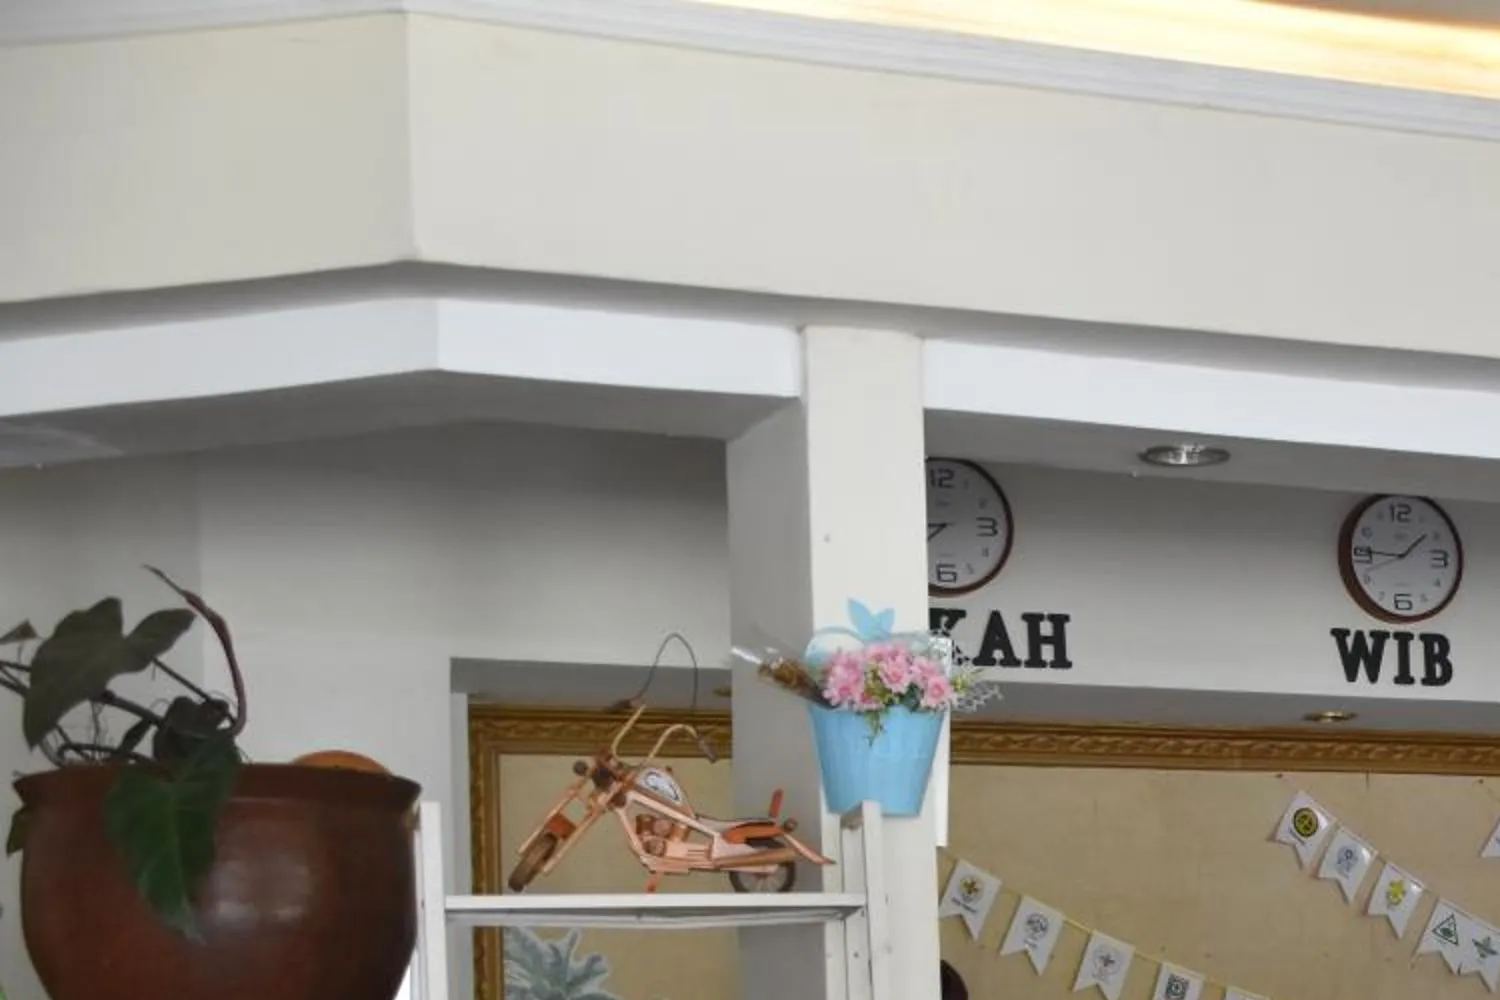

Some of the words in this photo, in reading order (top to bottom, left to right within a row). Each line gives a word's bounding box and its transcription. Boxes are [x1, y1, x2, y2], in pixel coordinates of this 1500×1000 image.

[930, 469, 955, 489] 12
[1389, 504, 1412, 523] 12
[976, 517, 998, 537] 3
[1353, 545, 1374, 566] 9
[1430, 549, 1449, 569] 3
[936, 563, 958, 583] 6
[1393, 593, 1413, 611] 6
[1330, 628, 1453, 686] WIB
